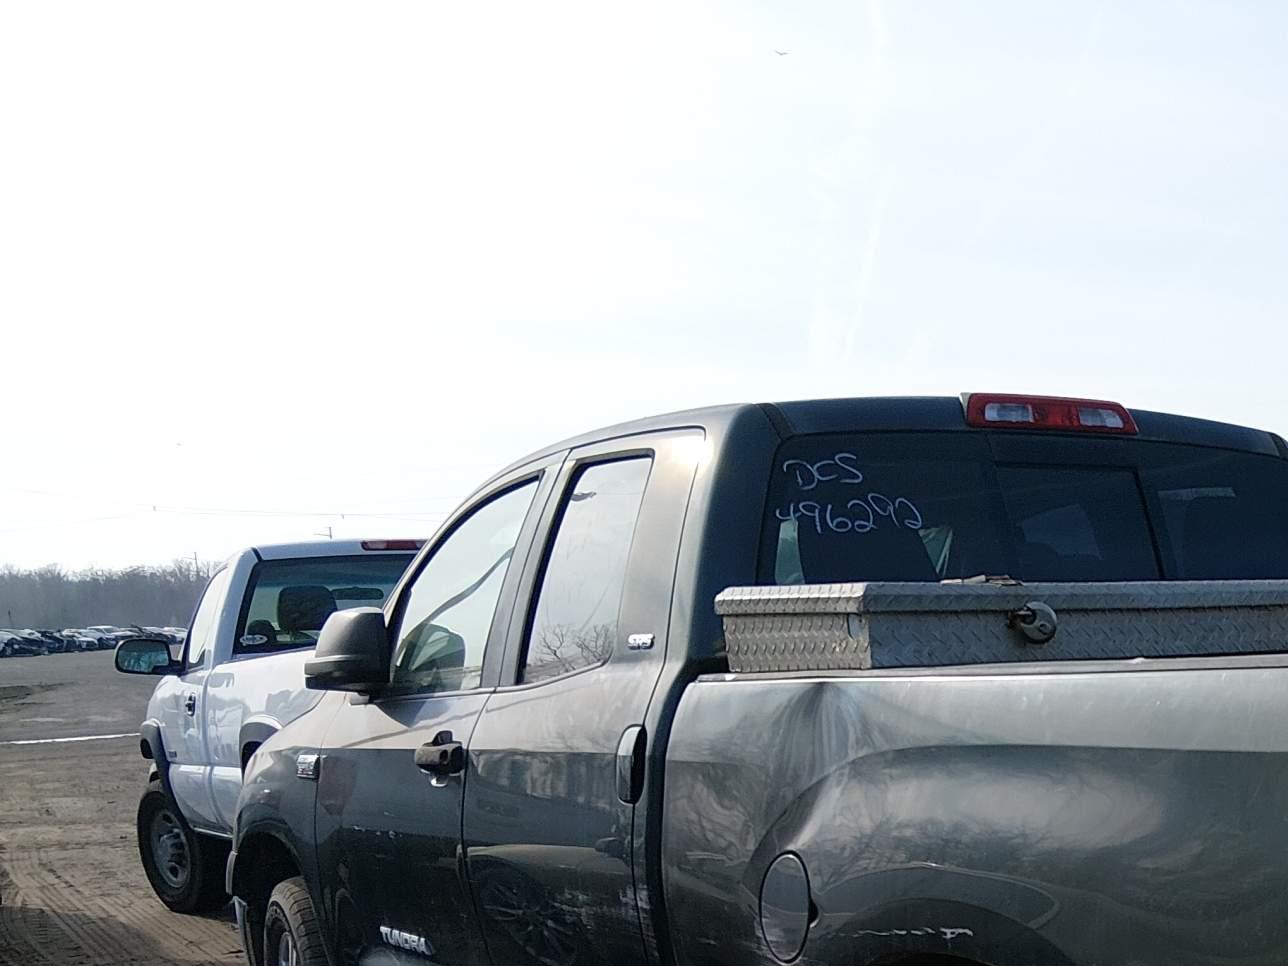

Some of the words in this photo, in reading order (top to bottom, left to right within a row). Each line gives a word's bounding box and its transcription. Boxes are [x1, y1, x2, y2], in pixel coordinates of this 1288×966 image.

[782, 452, 865, 491] DCS
[775, 492, 923, 536] 496292
[379, 926, 433, 956] TUNDRA
